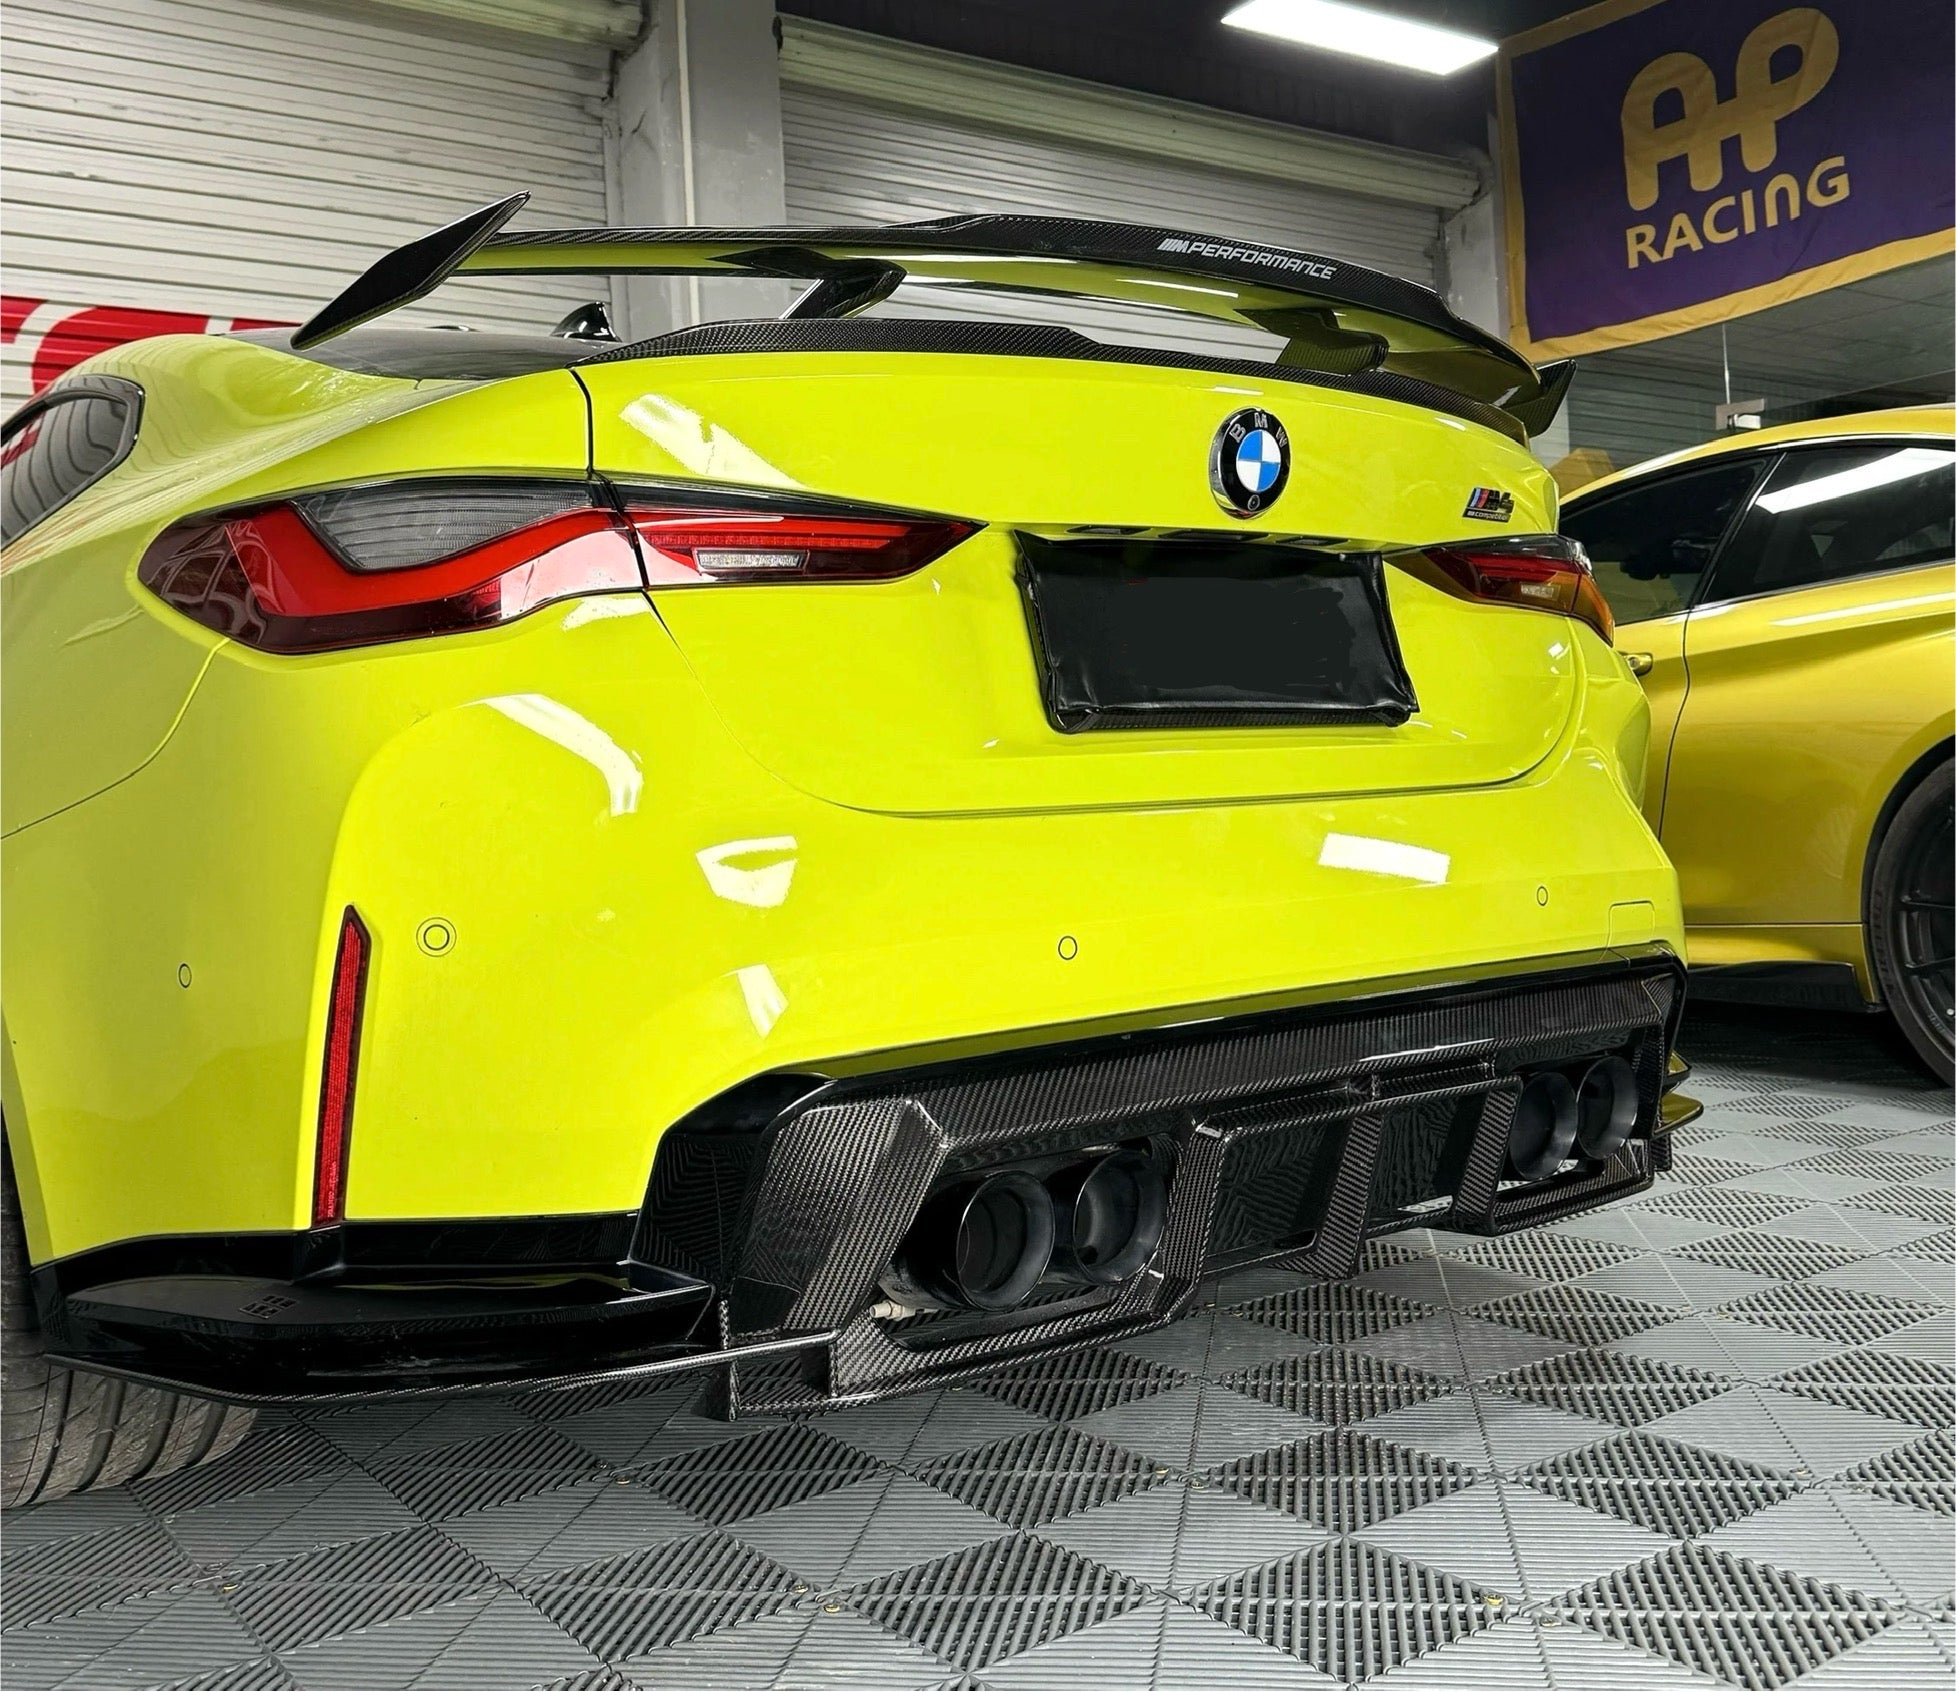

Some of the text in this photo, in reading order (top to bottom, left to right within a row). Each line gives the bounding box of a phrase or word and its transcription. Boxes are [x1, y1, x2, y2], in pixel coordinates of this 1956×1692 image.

[1620, 8, 1839, 211] AP
[1626, 156, 1851, 269] RACING
[1229, 412, 1288, 448] BMW
